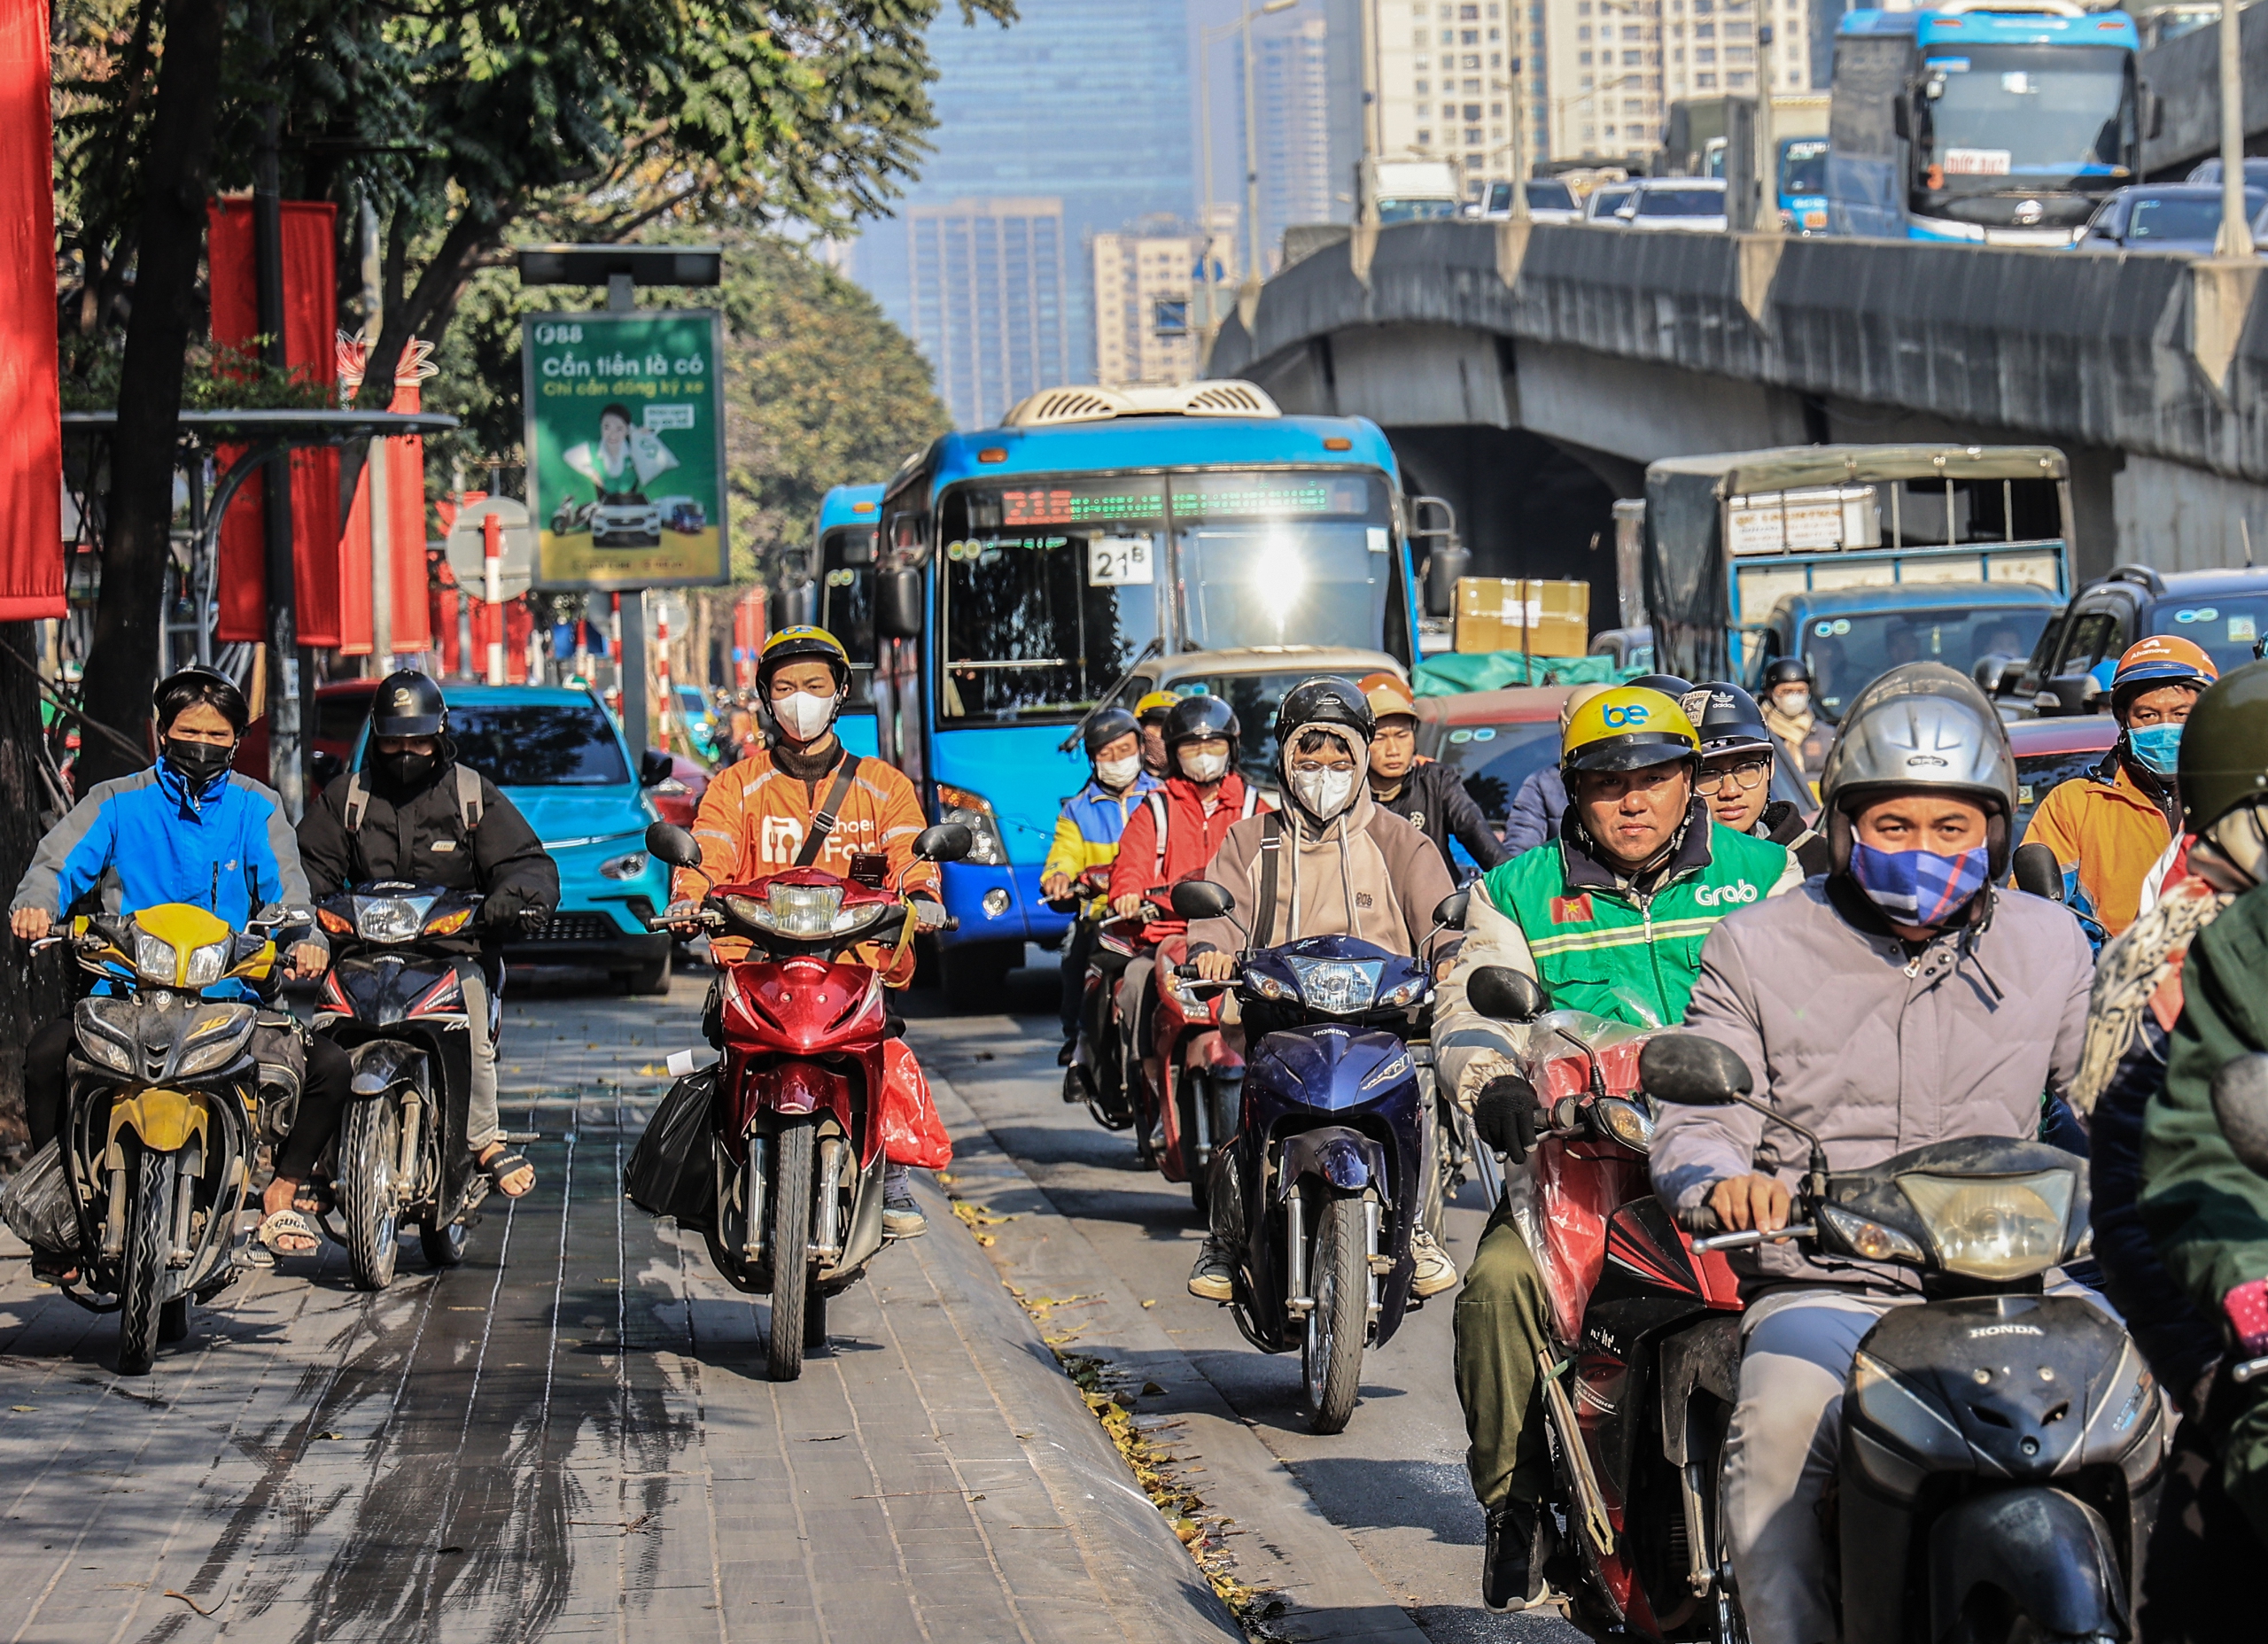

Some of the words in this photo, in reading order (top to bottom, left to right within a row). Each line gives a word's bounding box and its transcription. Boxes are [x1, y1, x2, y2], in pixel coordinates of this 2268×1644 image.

[542, 351, 591, 377] Cần
[596, 351, 640, 376] tiền
[645, 353, 668, 376] là
[673, 353, 704, 376] có
[684, 381, 704, 394] xe
[2130, 648, 2171, 660] Ahamove
[1602, 703, 1650, 728] be
[1695, 879, 1758, 906] Grab
[373, 955, 405, 965] HONDA
[783, 961, 827, 973] HONDA
[1313, 1028, 1350, 1037] HONDA
[1969, 1324, 2044, 1338] HONDA
